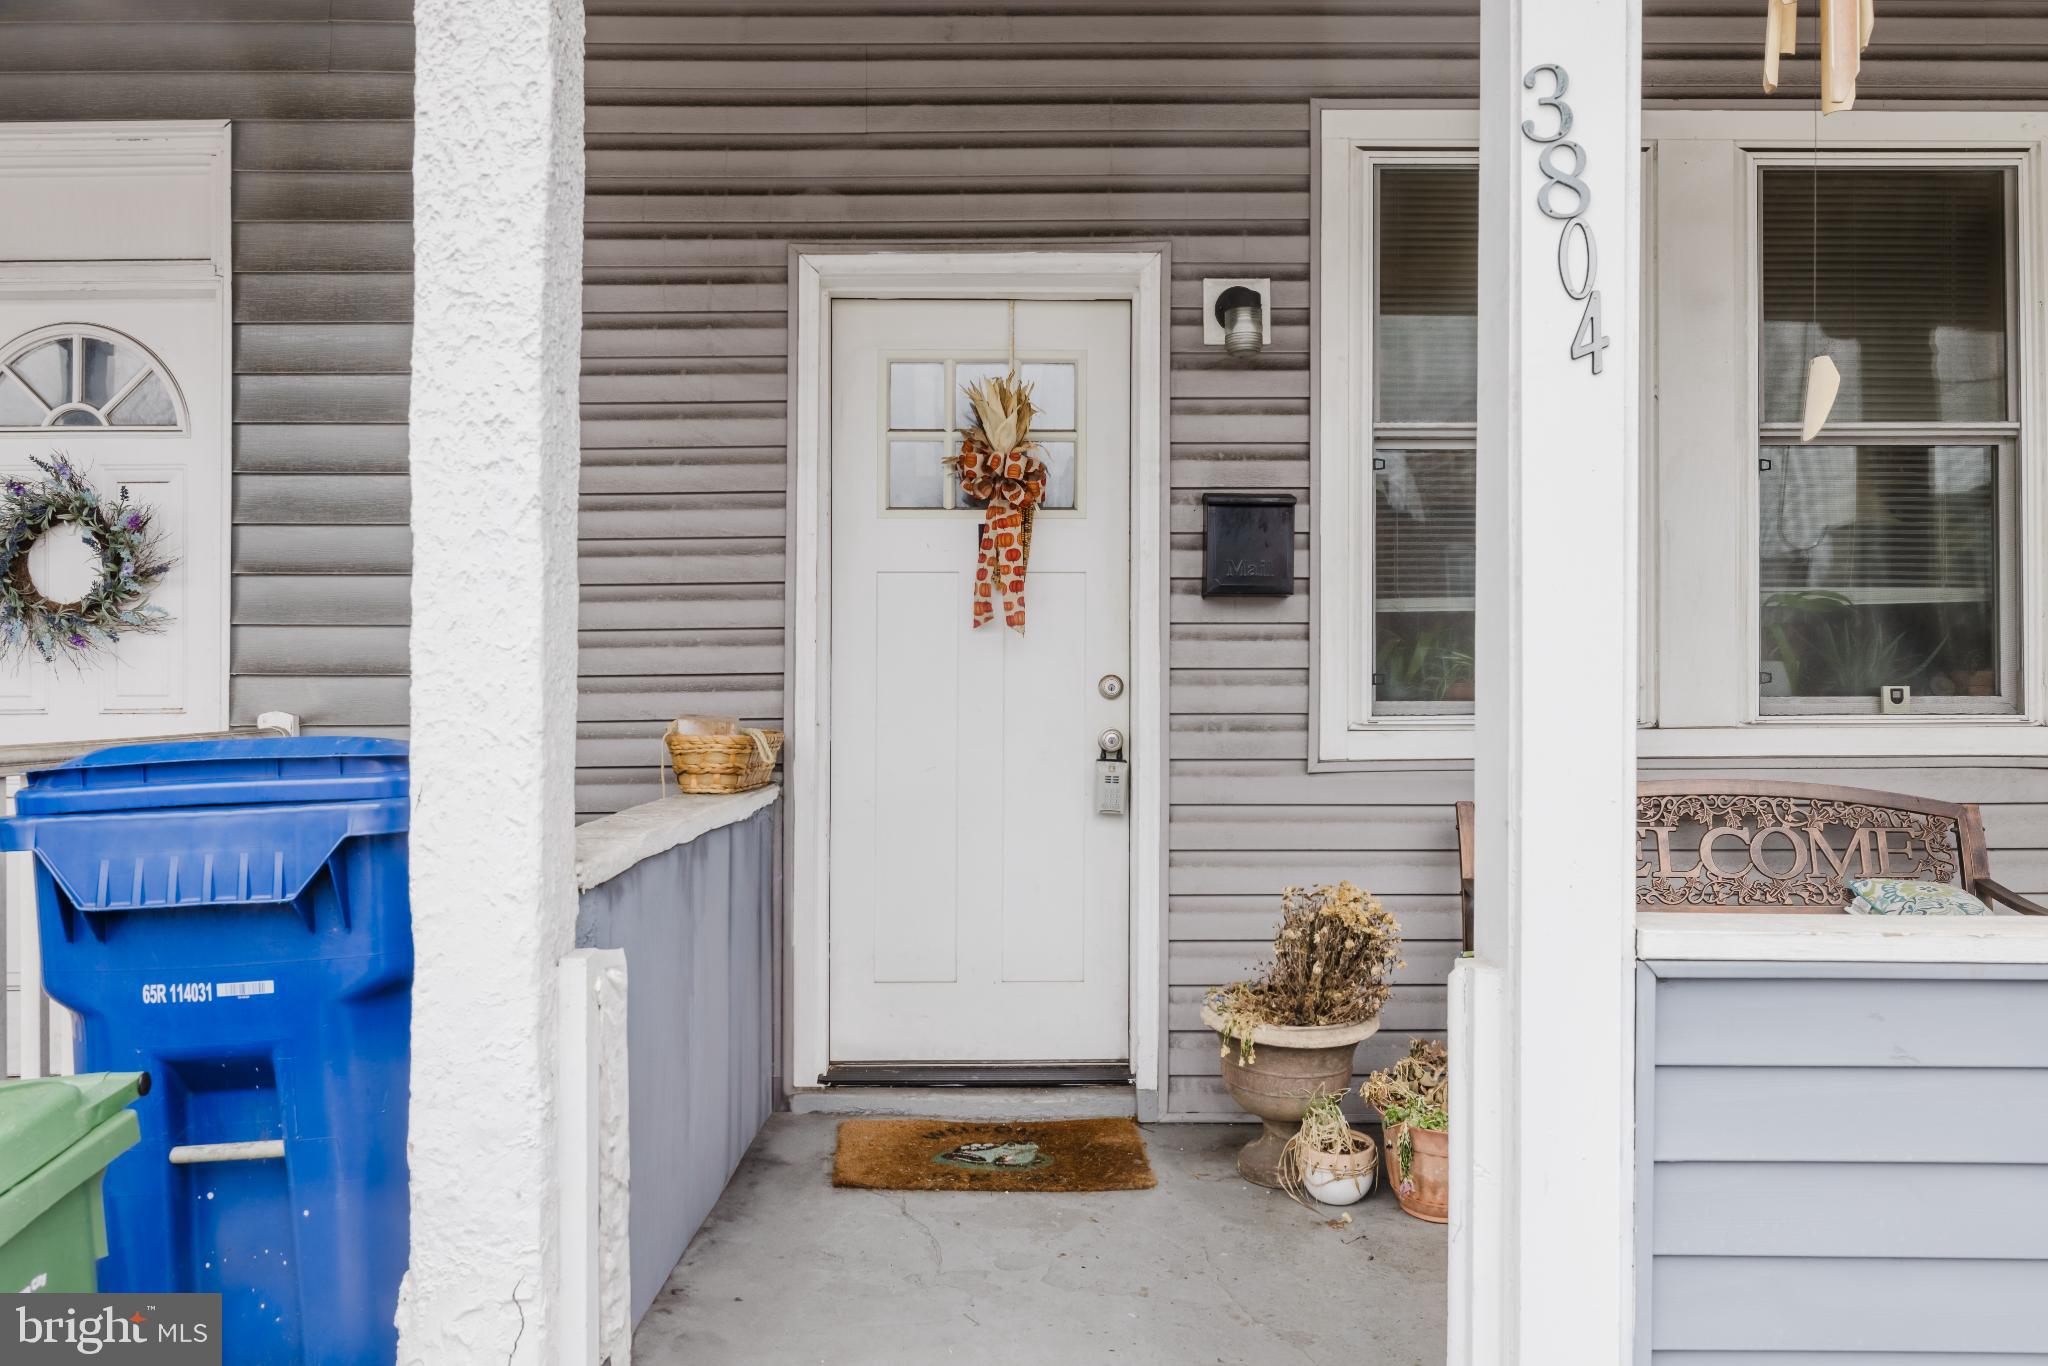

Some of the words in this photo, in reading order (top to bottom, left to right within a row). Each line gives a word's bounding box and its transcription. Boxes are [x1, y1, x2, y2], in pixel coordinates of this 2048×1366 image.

[1521, 63, 1610, 375] 3804
[1224, 559, 1275, 577] Mail
[142, 983, 168, 1004] 65R
[169, 982, 213, 1003] 114031
